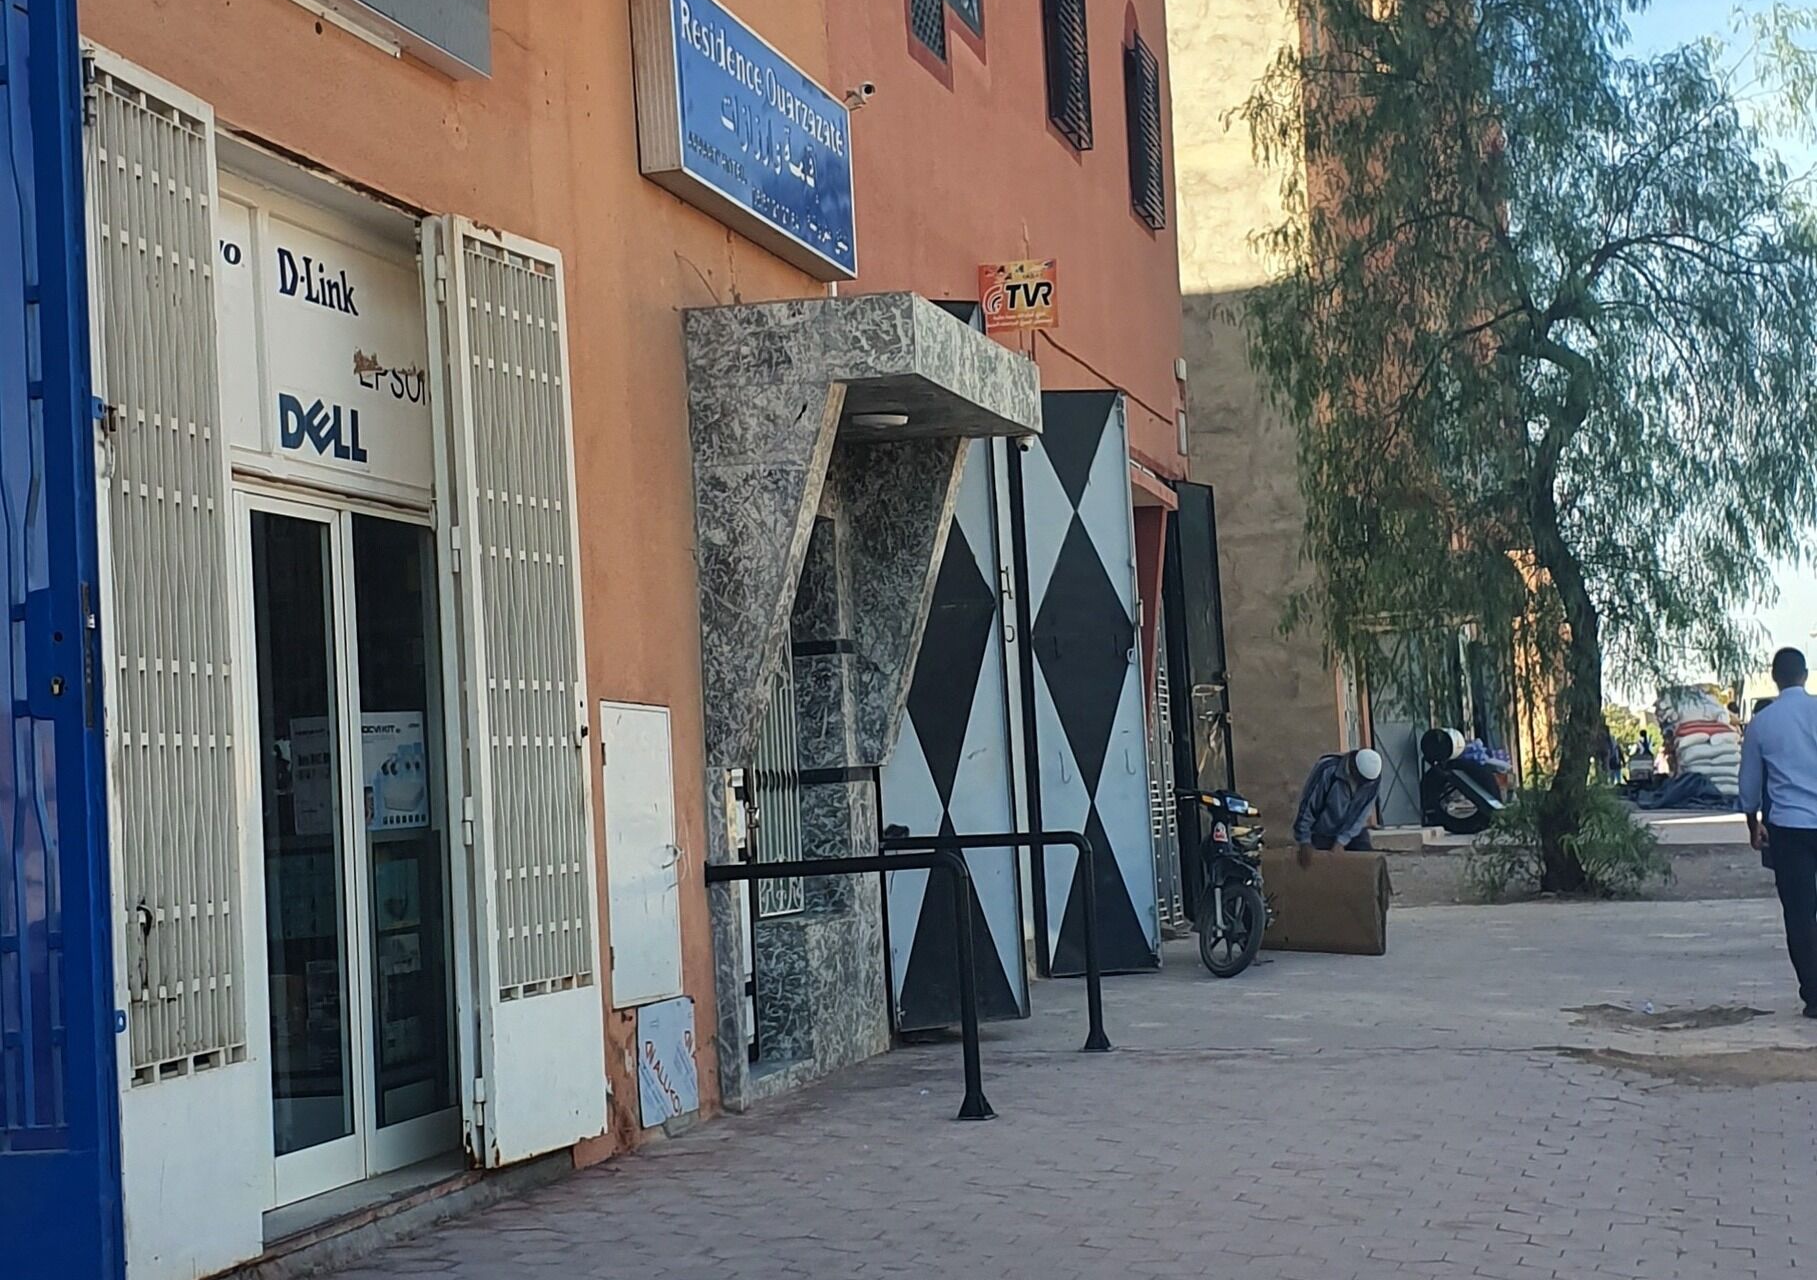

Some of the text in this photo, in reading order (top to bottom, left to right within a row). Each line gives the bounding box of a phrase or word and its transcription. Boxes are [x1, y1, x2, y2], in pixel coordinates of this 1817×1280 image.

[766, 67, 845, 157] Ouarzazate
[277, 247, 359, 316] D-Link
[1005, 281, 1053, 309] TVR
[279, 392, 368, 464] DELL
